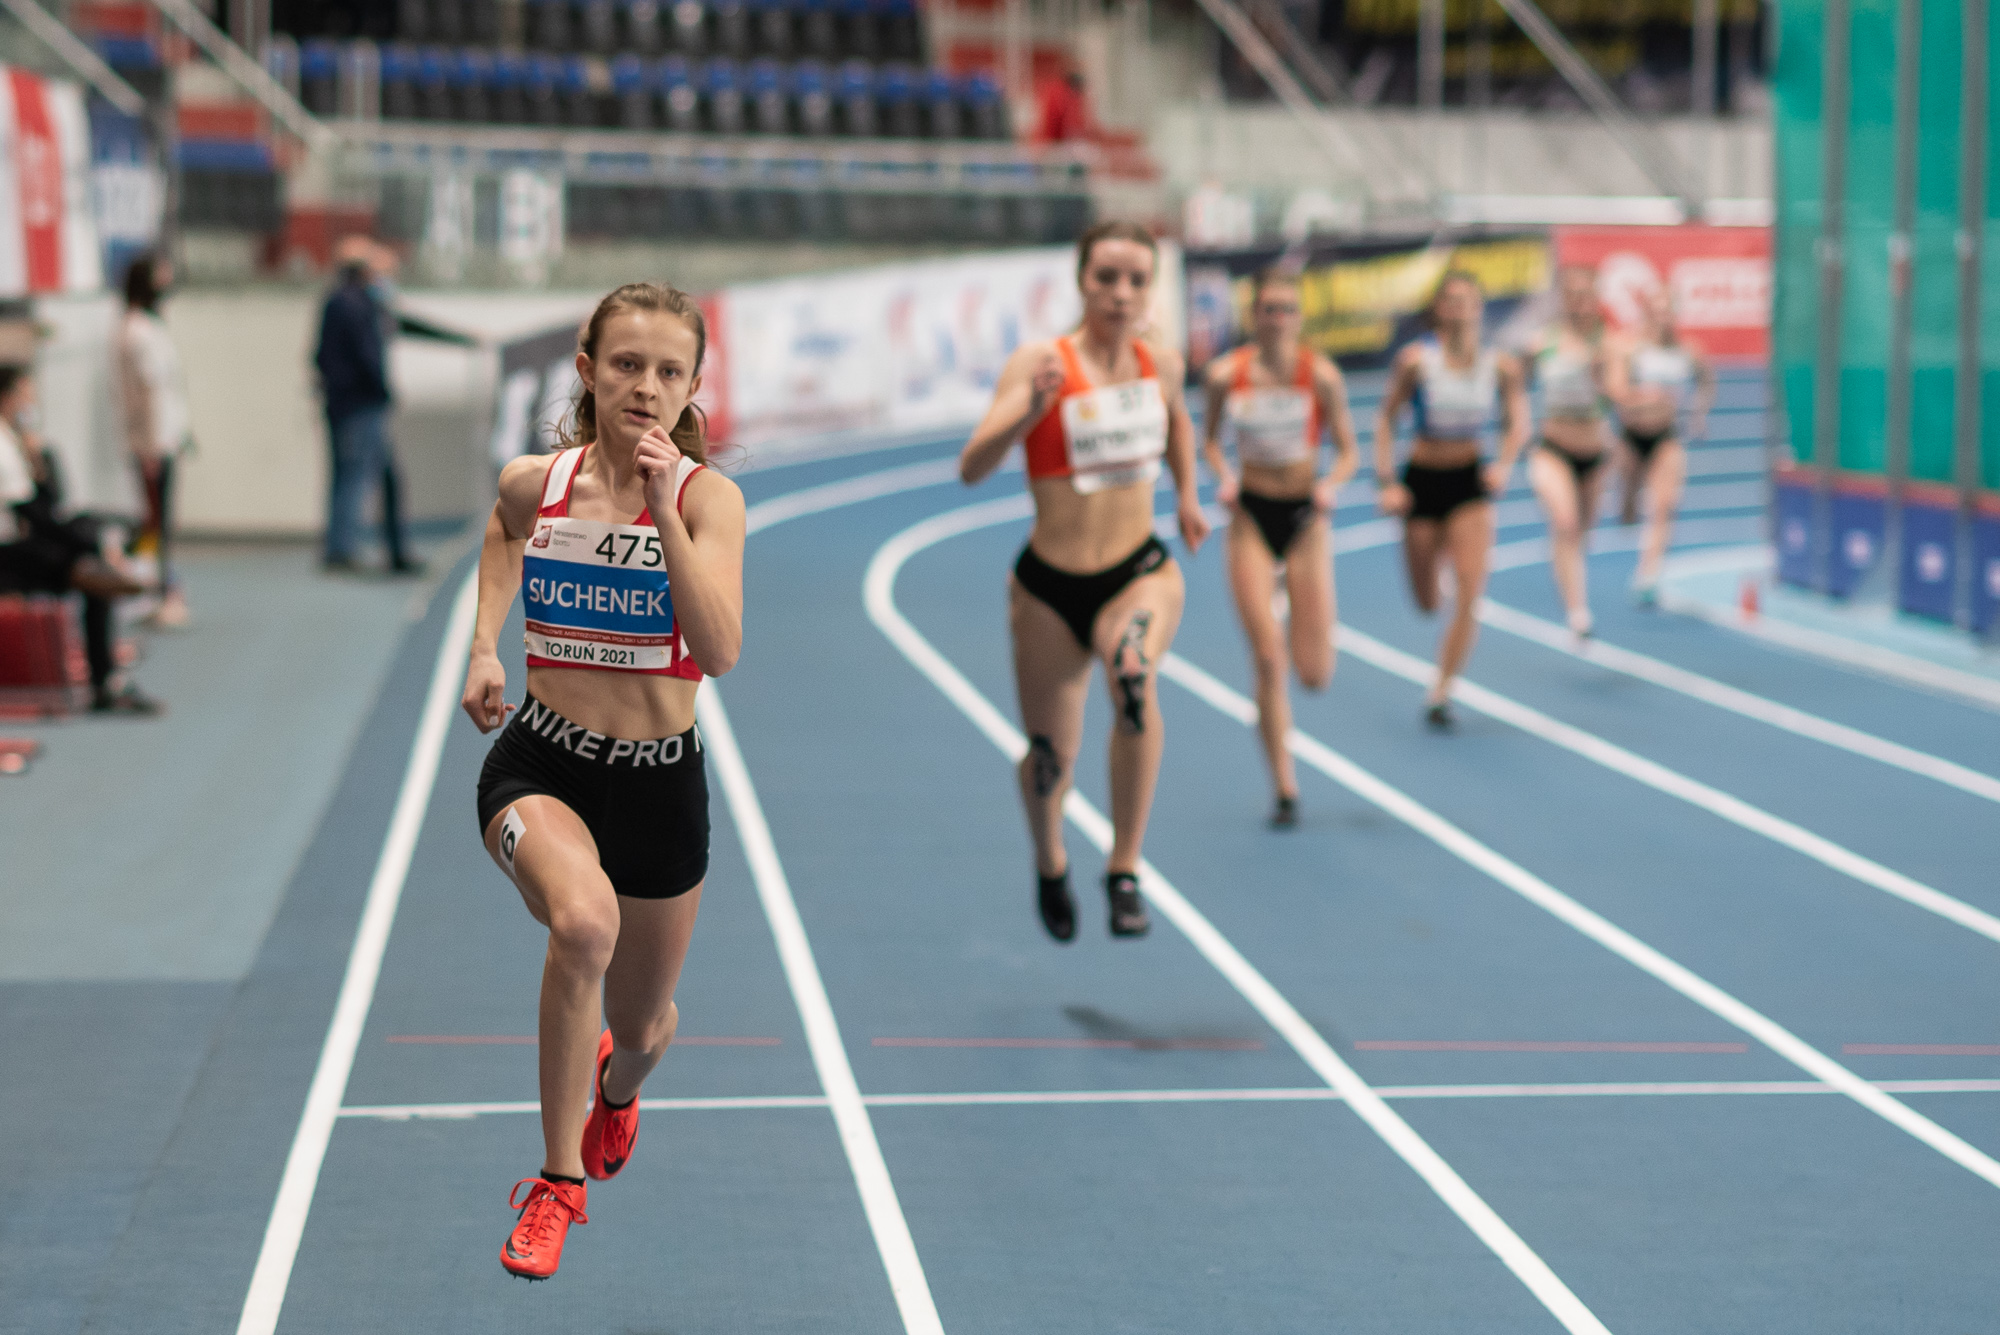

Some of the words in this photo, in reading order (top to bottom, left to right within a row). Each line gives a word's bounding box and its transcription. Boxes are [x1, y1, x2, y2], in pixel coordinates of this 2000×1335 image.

[595, 532, 663, 567] 475
[529, 577, 667, 617] SUCHENEK
[545, 641, 595, 661] TORUŃ
[600, 648, 635, 665] 2021
[564, 630, 611, 641] MISTRZOSTWA
[611, 635, 636, 644] POLSKI
[521, 699, 606, 760] NIKE
[606, 735, 683, 767] PRO
[501, 823, 516, 863] 6
